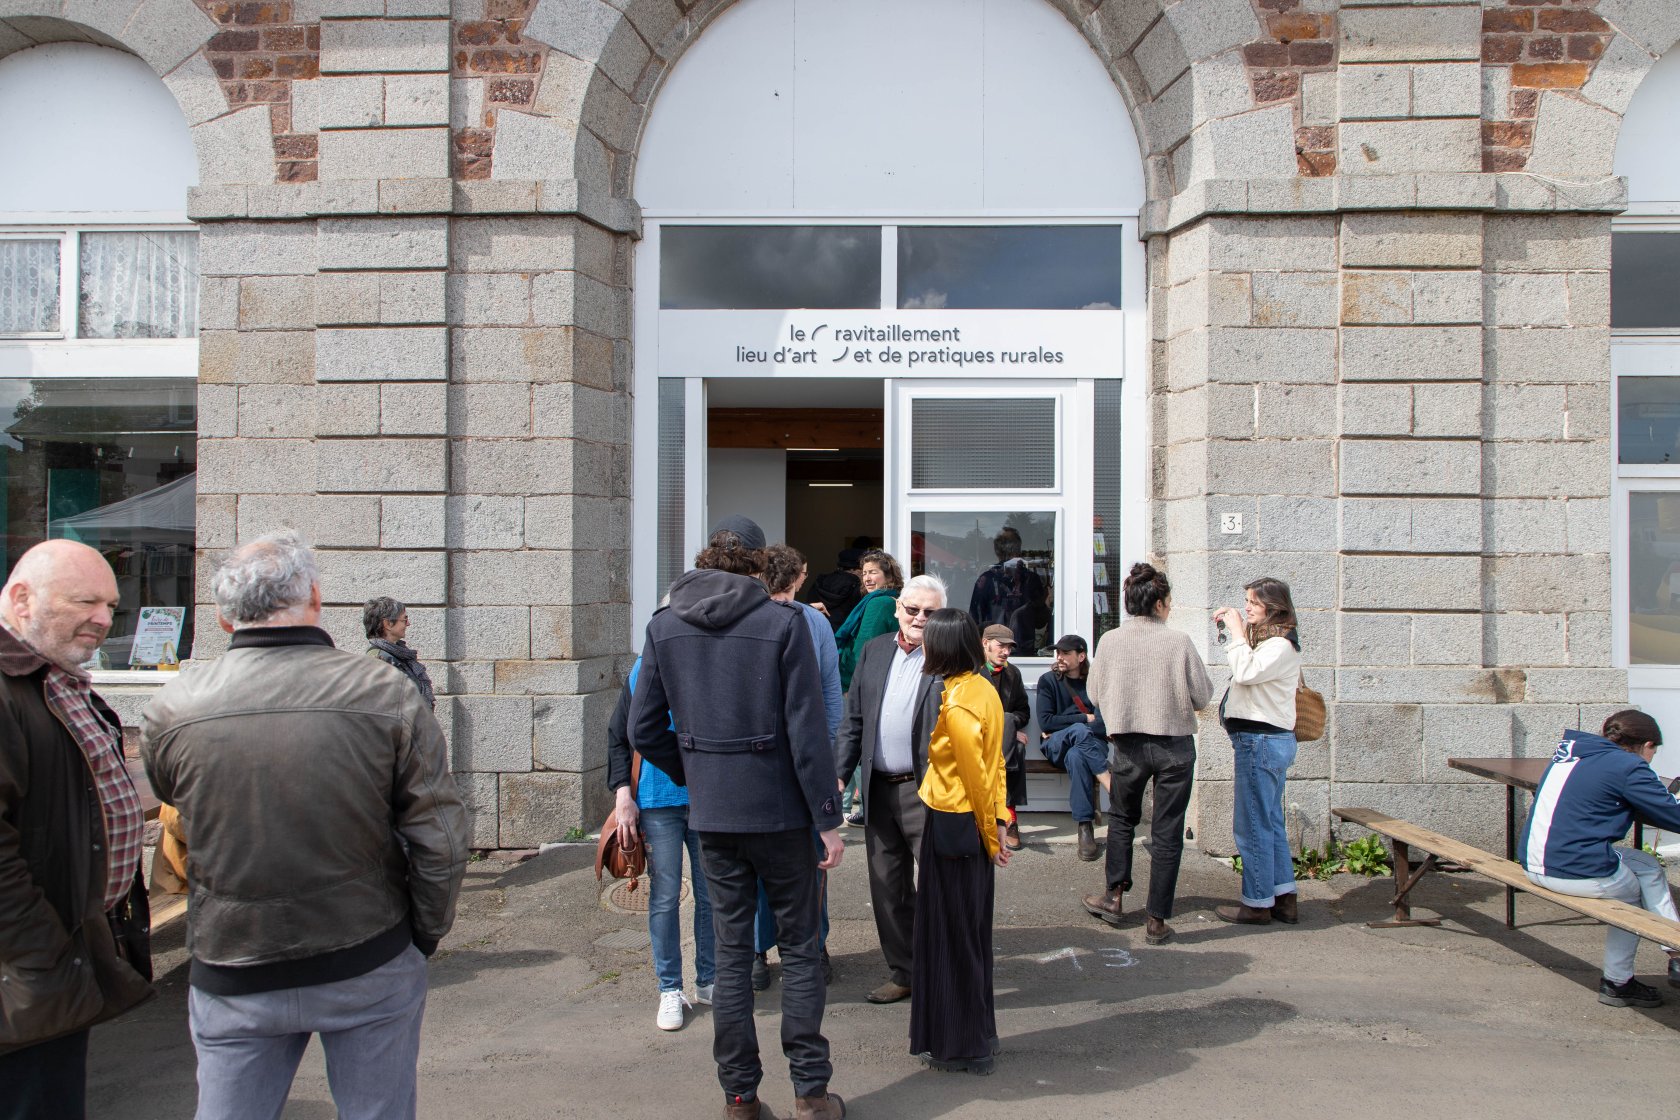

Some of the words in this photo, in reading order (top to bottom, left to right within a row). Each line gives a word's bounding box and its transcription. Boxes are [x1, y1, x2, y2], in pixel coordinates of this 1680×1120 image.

[790, 324, 806, 341] le
[835, 324, 960, 342] ravitaillement
[736, 345, 768, 363] lieu
[773, 346, 817, 363] d'art
[853, 349, 872, 363] et
[878, 345, 902, 363] de
[908, 346, 995, 367] pratiques
[1001, 345, 1064, 363] rurales
[1226, 516, 1236, 531] 3
